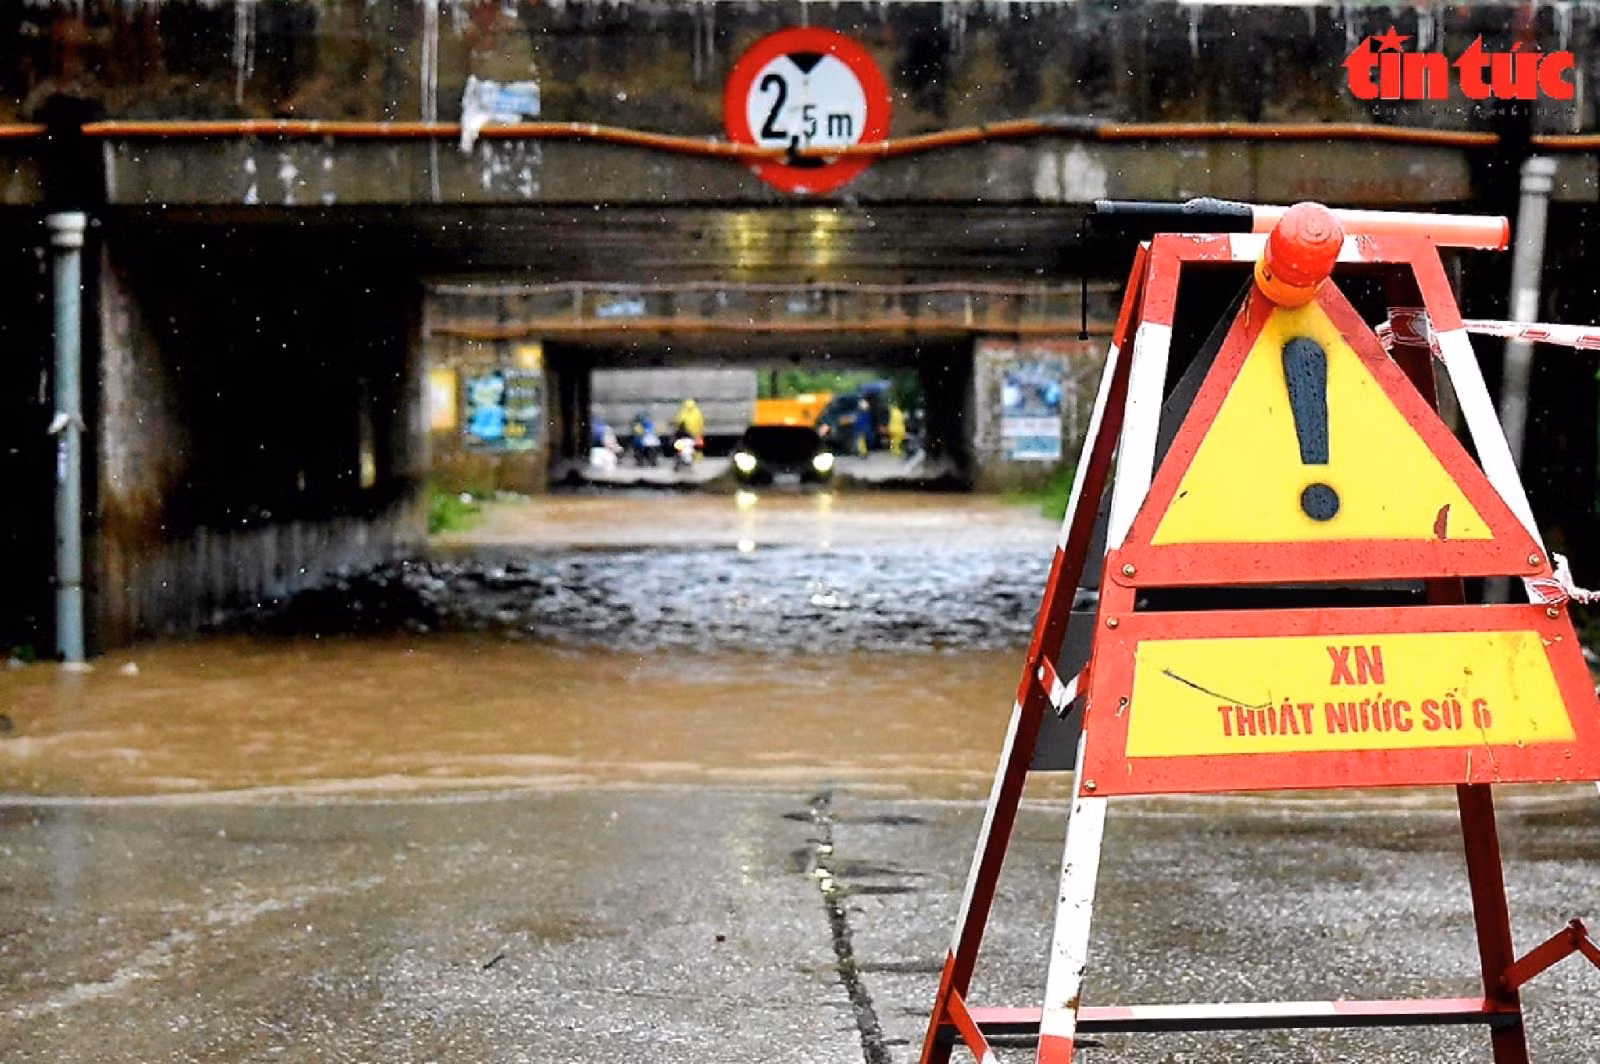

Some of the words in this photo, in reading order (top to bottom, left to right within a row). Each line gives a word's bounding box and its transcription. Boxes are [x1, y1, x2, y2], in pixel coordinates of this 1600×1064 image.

[827, 113, 854, 137] m
[1326, 645, 1385, 685] XN
[1217, 697, 1315, 737] THOÁT
[1324, 692, 1414, 734] NƯỚC
[1421, 688, 1463, 731] SỐ
[1471, 697, 1493, 729] 6
